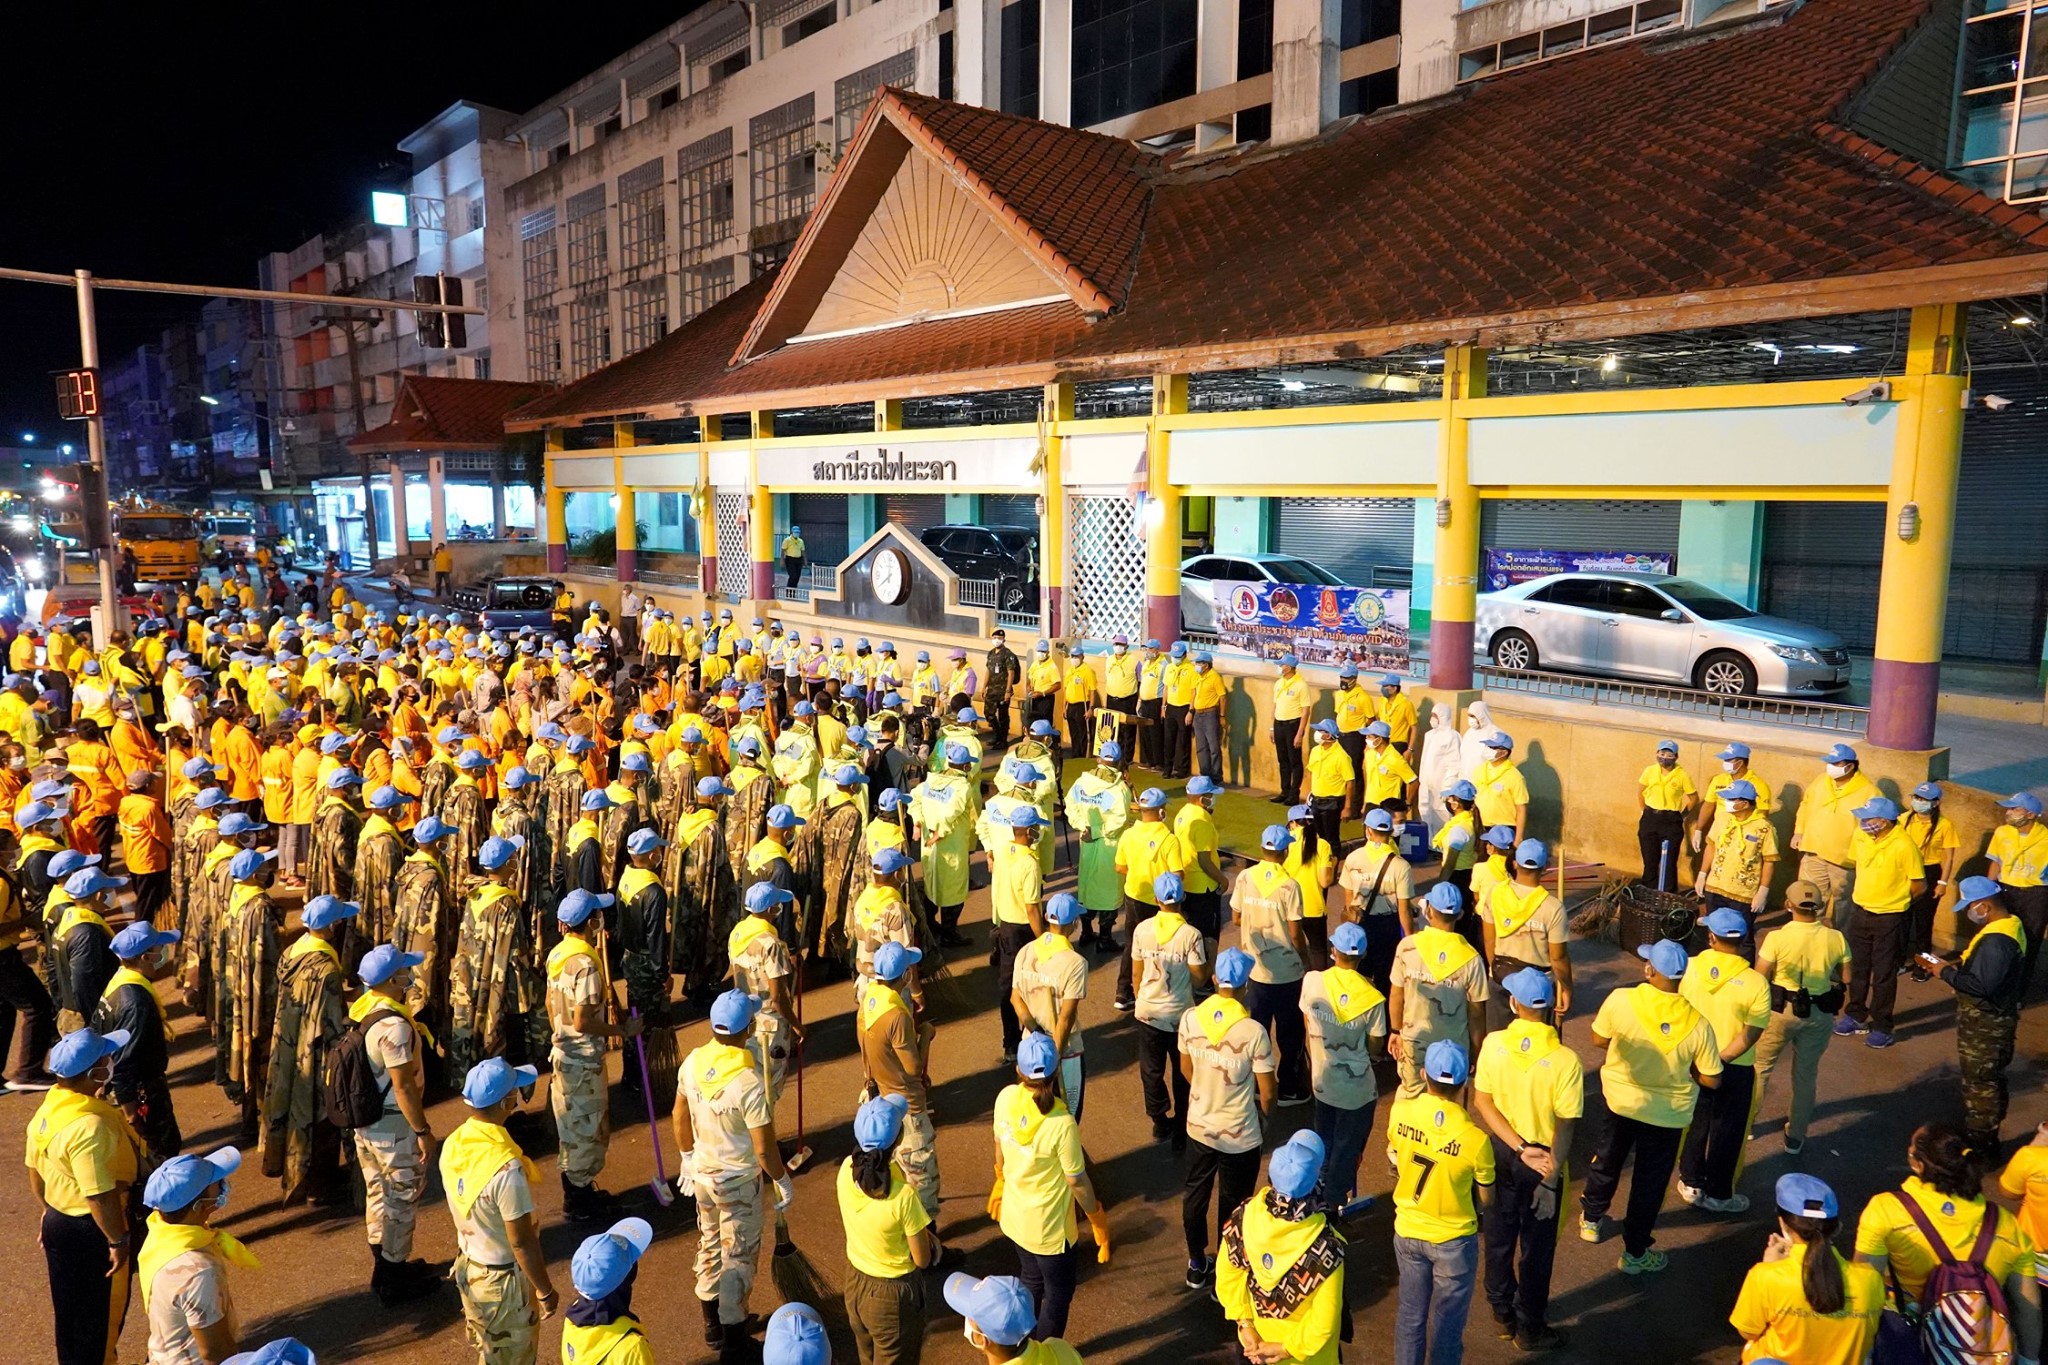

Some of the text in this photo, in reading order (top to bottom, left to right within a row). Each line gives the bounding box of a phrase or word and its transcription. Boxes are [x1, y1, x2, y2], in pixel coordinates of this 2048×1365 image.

[69, 371, 97, 414] 73
[813, 448, 957, 481] สถานีรถไฟยะลา
[1505, 552, 1513, 563] 5
[1349, 633, 1383, 645] COVID
[1391, 637, 1402, 648] 19
[1411, 1152, 1438, 1204] 7
